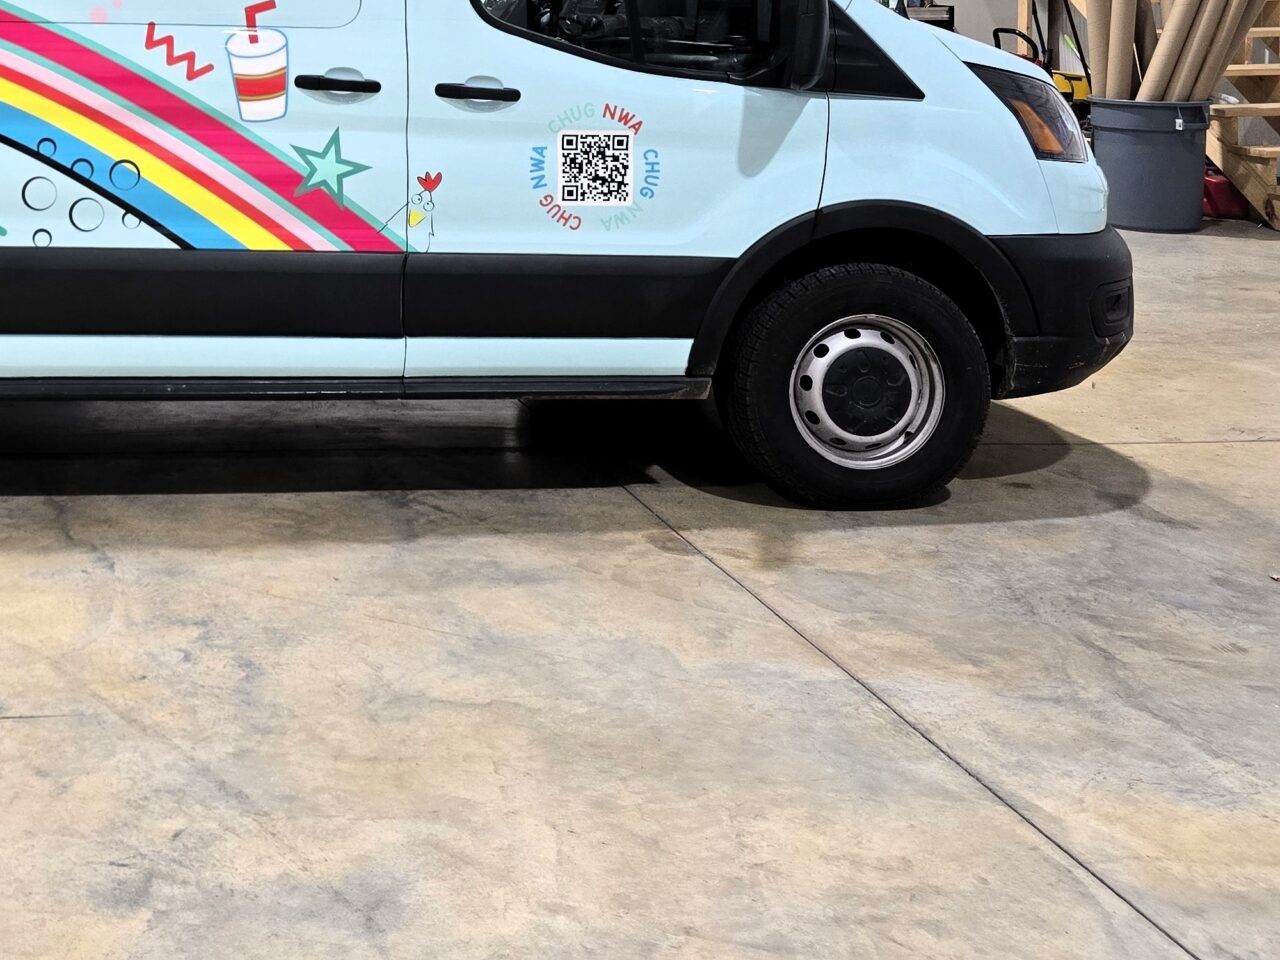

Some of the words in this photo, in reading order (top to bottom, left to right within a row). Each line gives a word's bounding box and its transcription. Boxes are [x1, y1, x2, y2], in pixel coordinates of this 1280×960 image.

[548, 102, 596, 133] CHUG
[602, 103, 643, 135] NWA
[530, 146, 548, 189] NWA
[639, 149, 660, 199] CHUG
[540, 194, 582, 231] CHUG
[601, 201, 644, 232] NWA
